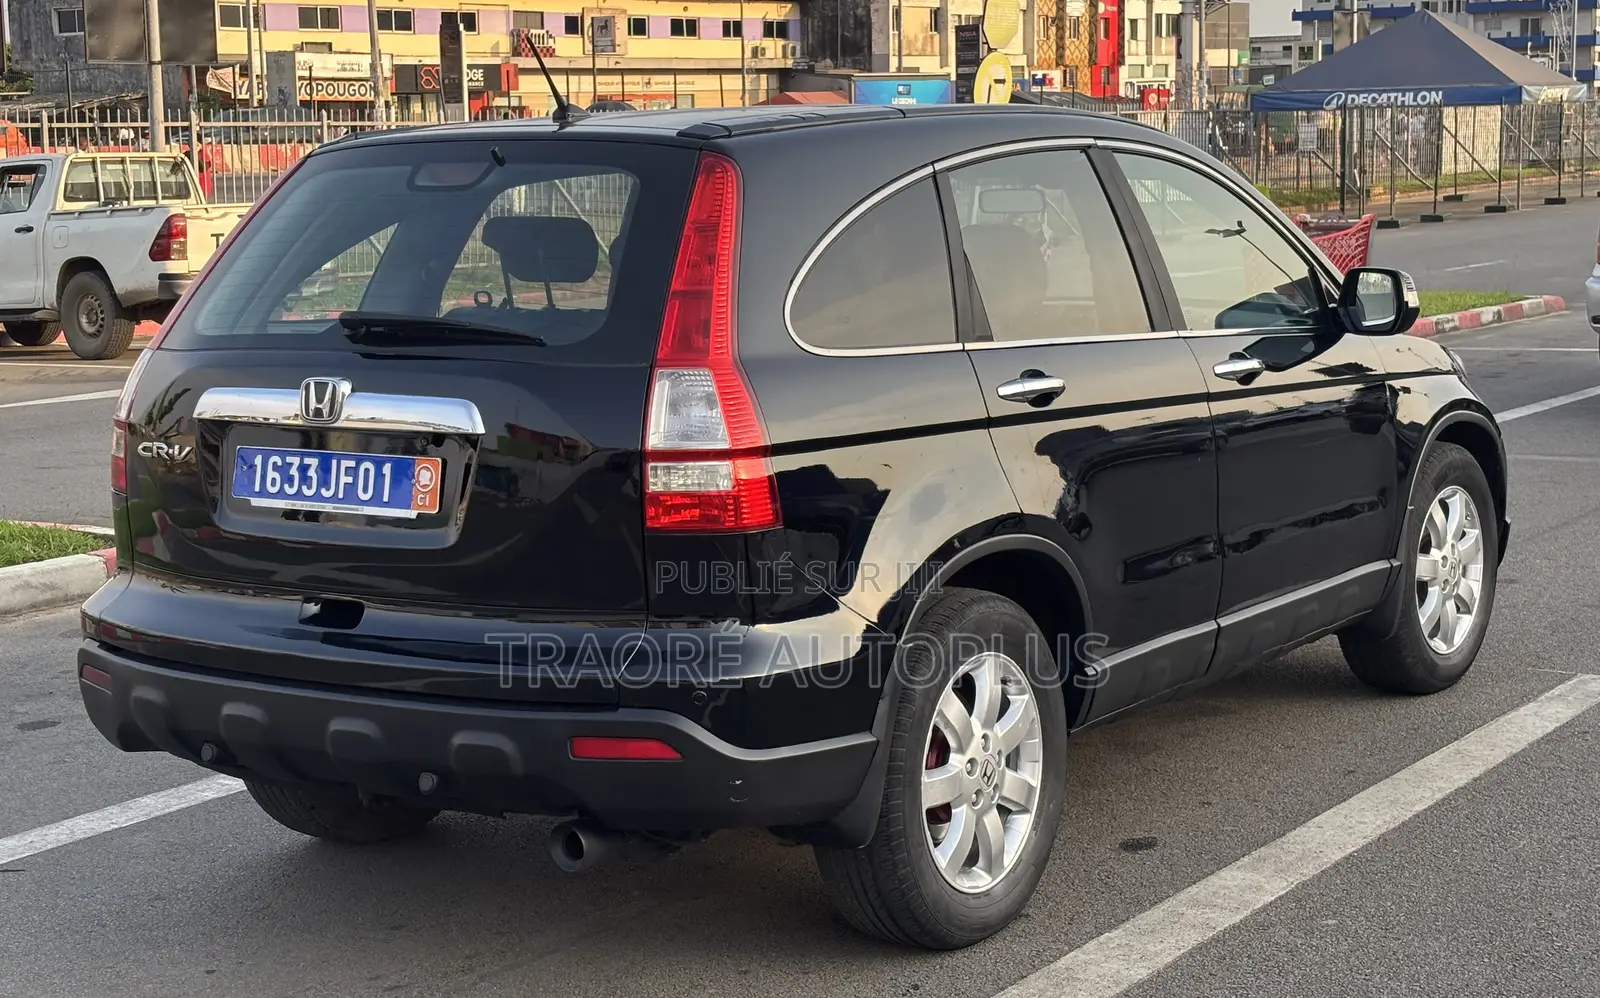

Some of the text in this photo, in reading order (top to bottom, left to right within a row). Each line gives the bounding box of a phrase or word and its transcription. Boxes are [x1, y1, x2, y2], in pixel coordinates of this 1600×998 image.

[1347, 90, 1443, 107] DECATHLON
[137, 441, 194, 461] CR-V
[253, 454, 392, 503] 1633JF01
[417, 494, 430, 507] CI
